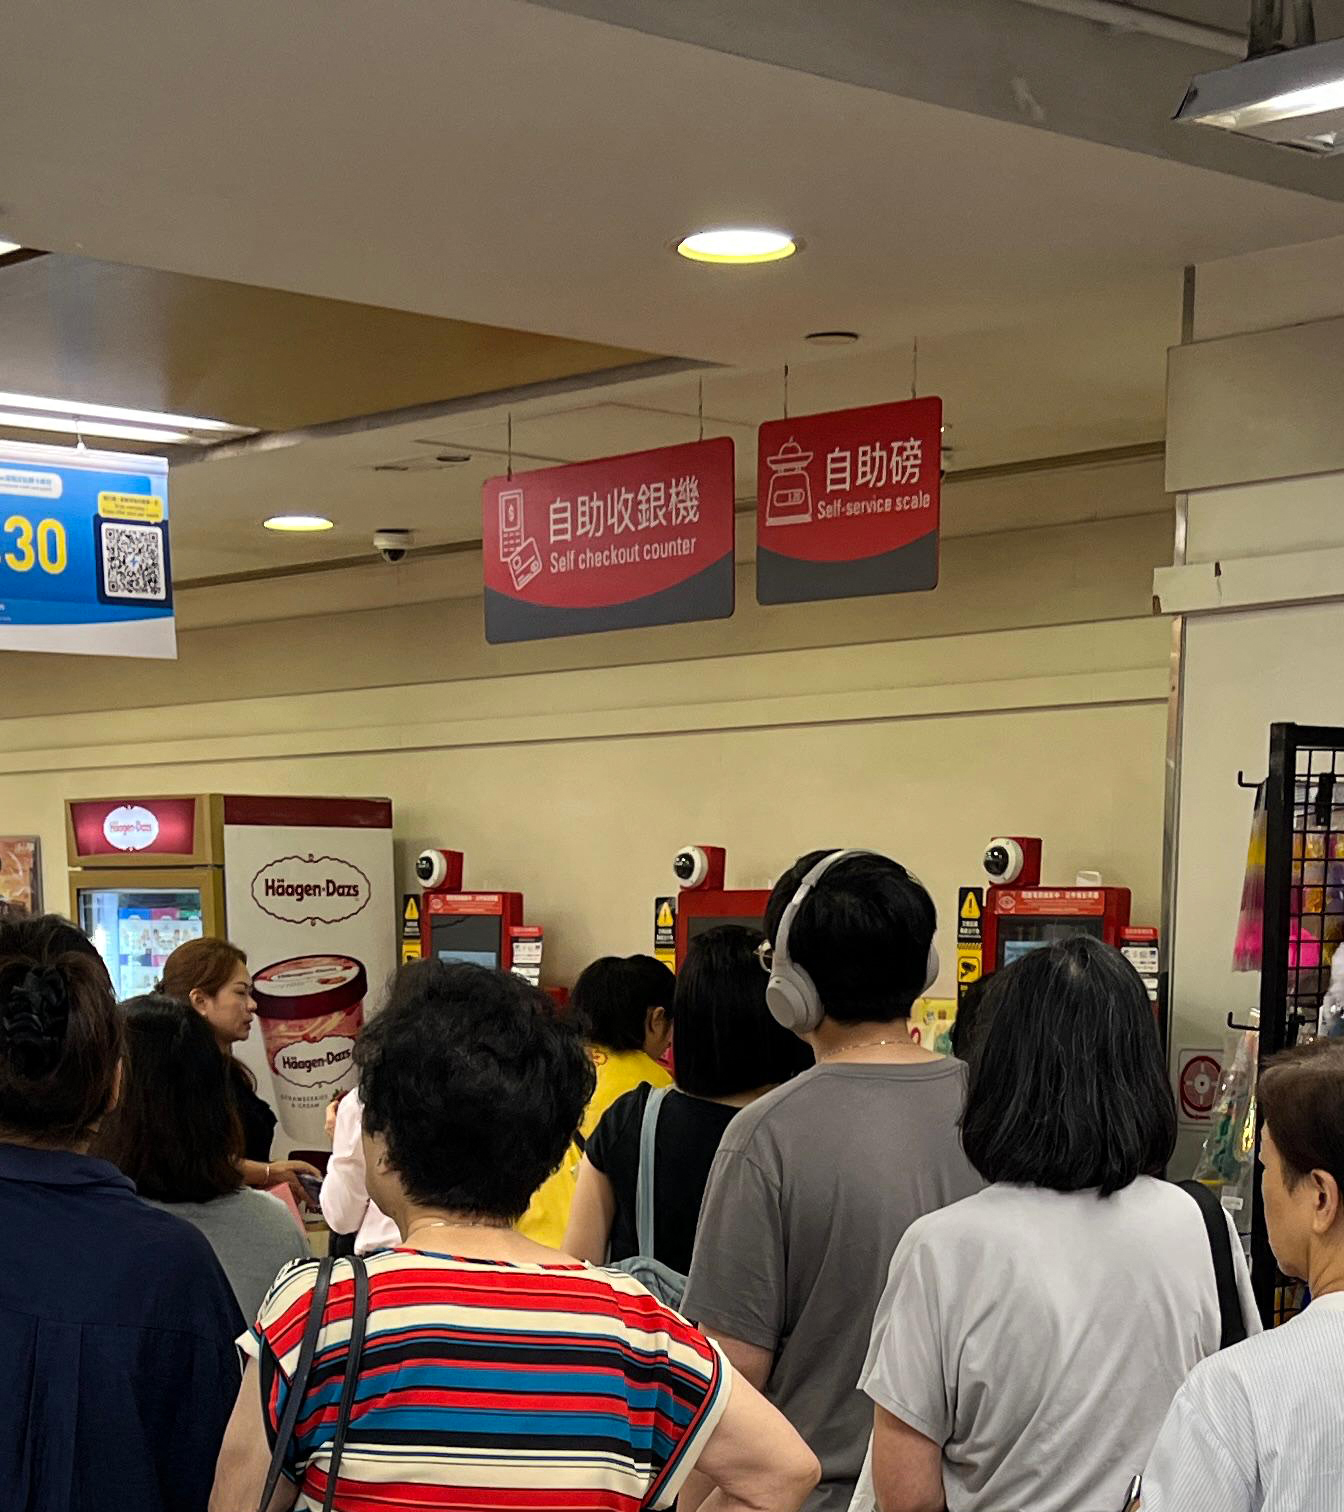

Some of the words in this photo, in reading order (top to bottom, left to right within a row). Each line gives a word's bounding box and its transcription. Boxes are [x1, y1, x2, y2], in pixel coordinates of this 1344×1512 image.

[824, 437, 923, 494] 自助磅
[548, 475, 700, 544] 自助收銀機
[816, 496, 892, 520] Self-service
[894, 493, 931, 512] scale
[549, 548, 576, 574] Self
[578, 542, 641, 570] checkout
[651, 537, 696, 561] counter
